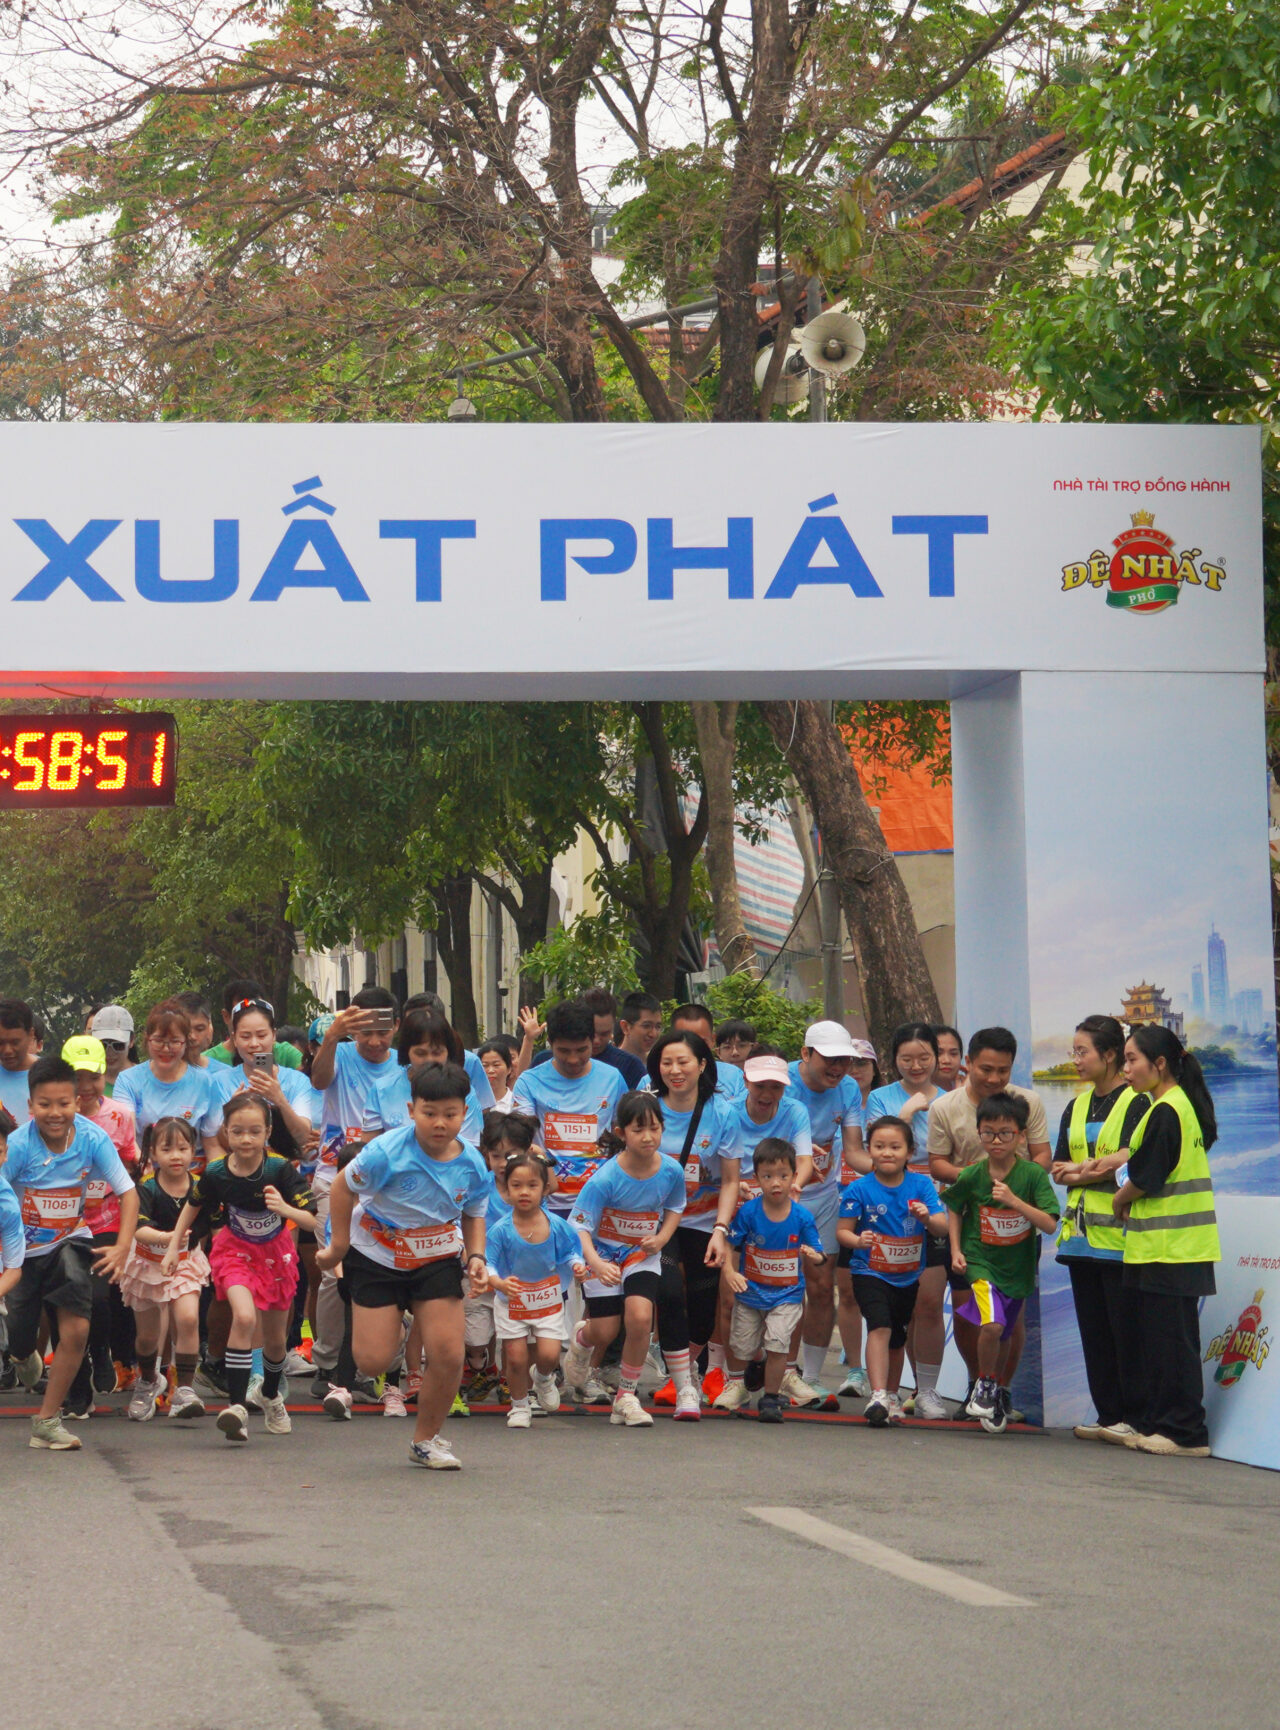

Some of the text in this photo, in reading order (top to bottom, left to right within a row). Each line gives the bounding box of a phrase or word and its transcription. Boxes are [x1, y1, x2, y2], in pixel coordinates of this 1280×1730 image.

[1053, 476, 1230, 494] NHÀ TÀI TRỢ ĐỒNG HÀNH
[13, 476, 989, 604] XUẤT PHÁT
[1061, 548, 1227, 592] ĐỆ NHẤT
[1128, 588, 1156, 605] PHỞ
[564, 1125, 591, 1135] 1151-1
[41, 1199, 76, 1210] 1108-1
[245, 1212, 278, 1230] 3068
[618, 1220, 655, 1231] 1144-3
[414, 1233, 455, 1250] 1134-3
[888, 1246, 919, 1257] 1122-3
[758, 1261, 796, 1272] 1065-3
[526, 1287, 558, 1303] 1145-1
